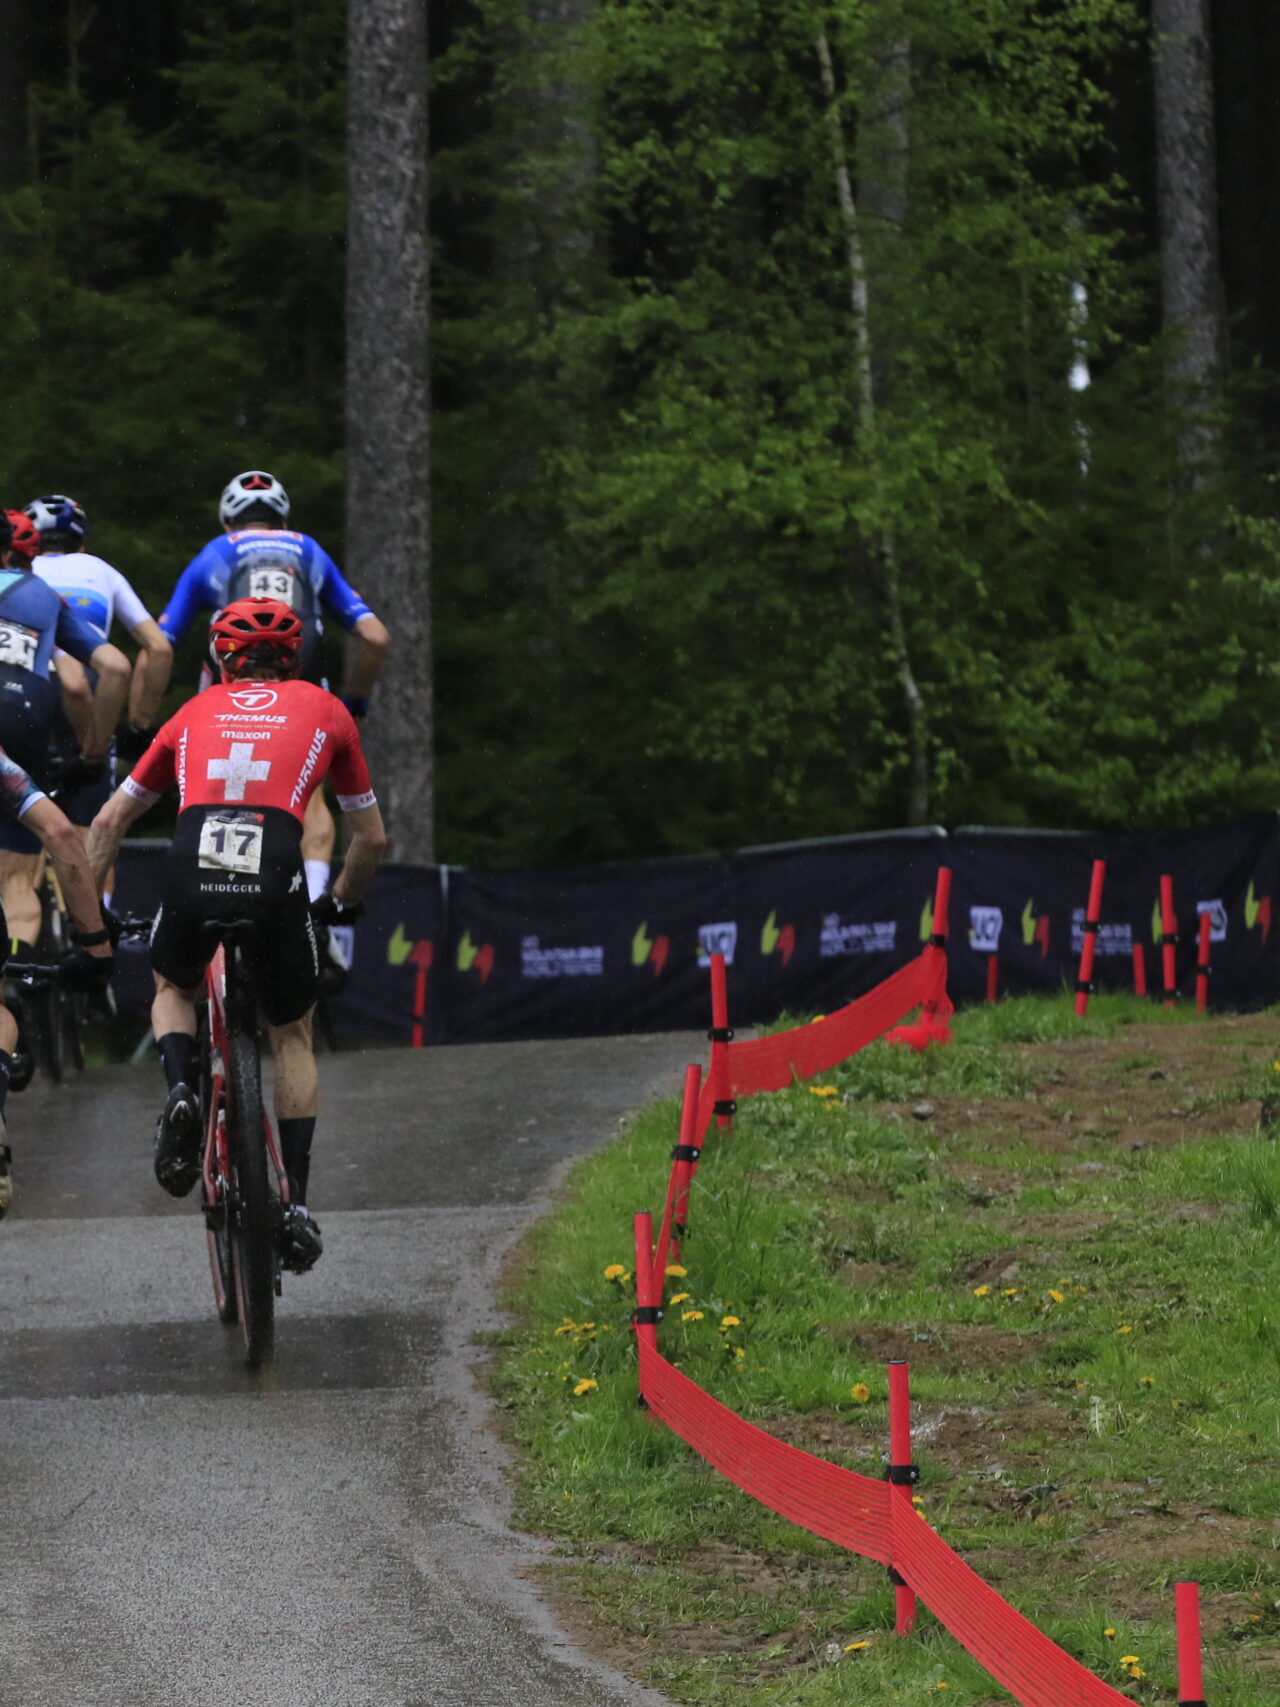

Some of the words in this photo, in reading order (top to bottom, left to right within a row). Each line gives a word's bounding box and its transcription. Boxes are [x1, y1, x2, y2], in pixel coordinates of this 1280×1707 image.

[221, 730, 271, 740] maxon
[210, 827, 257, 856] 17
[200, 883, 262, 893] HEIDEGGER
